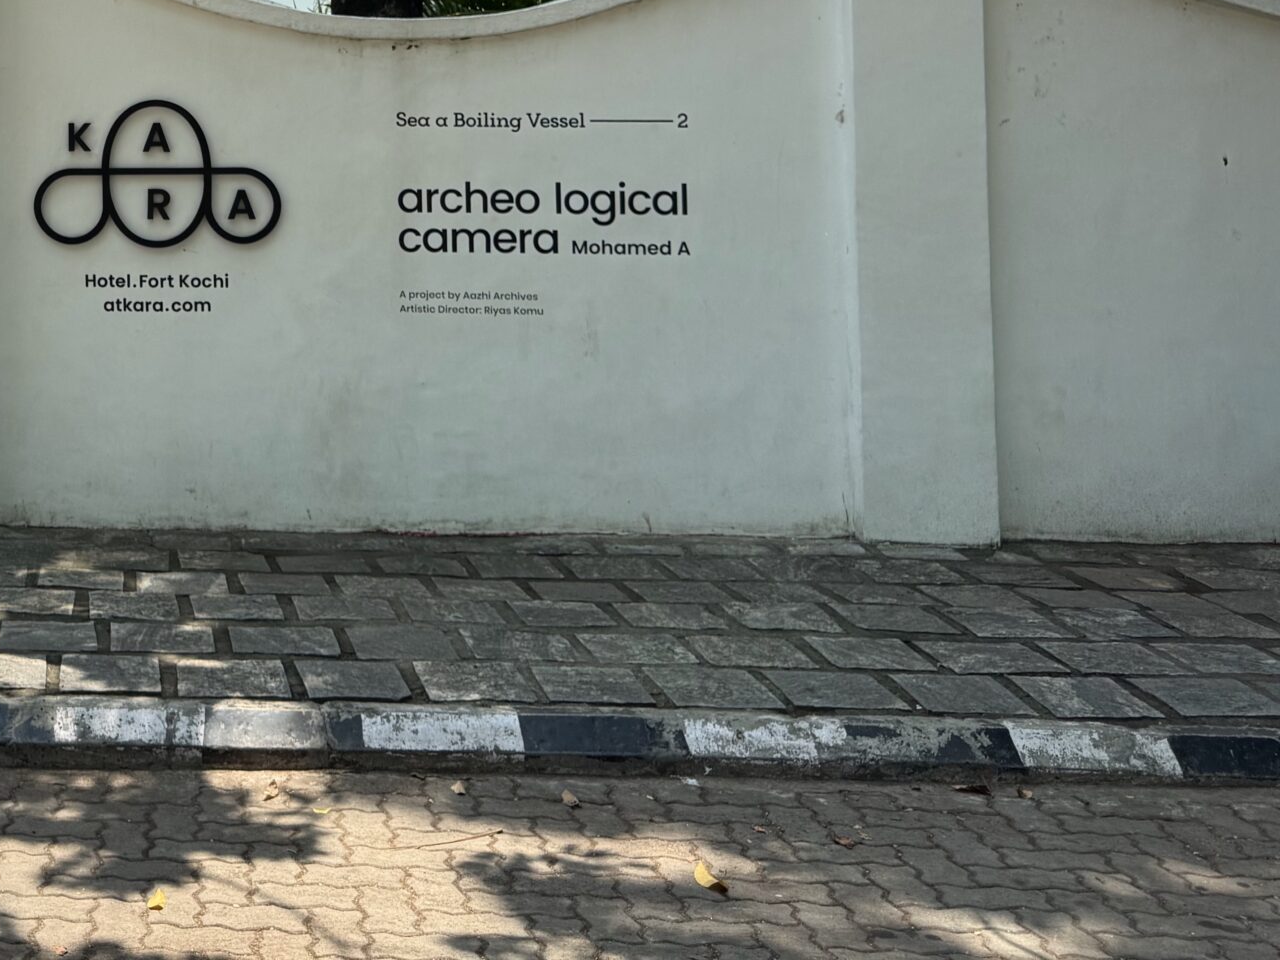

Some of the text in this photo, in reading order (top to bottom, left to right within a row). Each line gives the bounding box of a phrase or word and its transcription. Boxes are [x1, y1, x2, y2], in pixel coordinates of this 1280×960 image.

[396, 111, 689, 133] Sea a Boiling Vessel 2
[397, 181, 689, 227] archeo logical
[398, 227, 691, 256] camera Mohamed A
[178, 273, 229, 289] Kochi
[399, 289, 539, 302] A project by Aazhi Archives
[103, 297, 212, 313] atkara.com
[399, 303, 545, 317] Artistic Director: Riyas Komu
